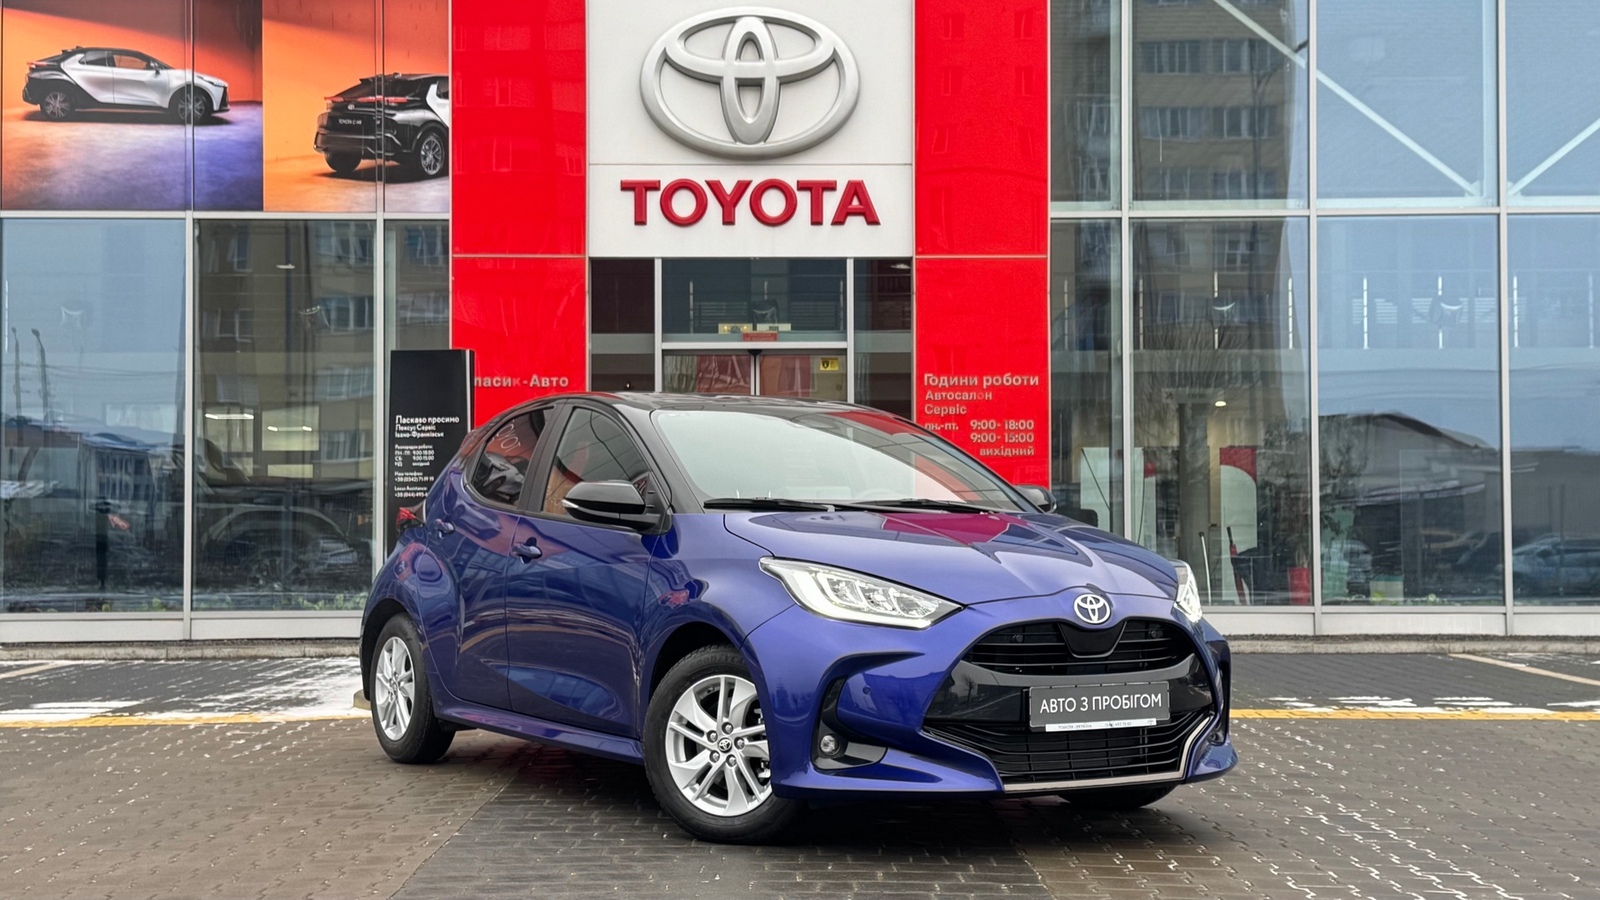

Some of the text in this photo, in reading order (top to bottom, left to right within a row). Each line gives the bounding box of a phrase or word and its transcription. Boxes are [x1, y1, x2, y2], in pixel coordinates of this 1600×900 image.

[620, 179, 881, 226] TOYOTA
[924, 373, 1039, 389] Години роботи
[925, 391, 992, 400] Автосалон
[924, 404, 967, 417] Сервіс
[396, 415, 460, 425] Ласкаво просимо
[980, 446, 1035, 457] вихідний
[1040, 697, 1077, 714] АВТО
[1092, 693, 1162, 711] ПРОБІГОМ
